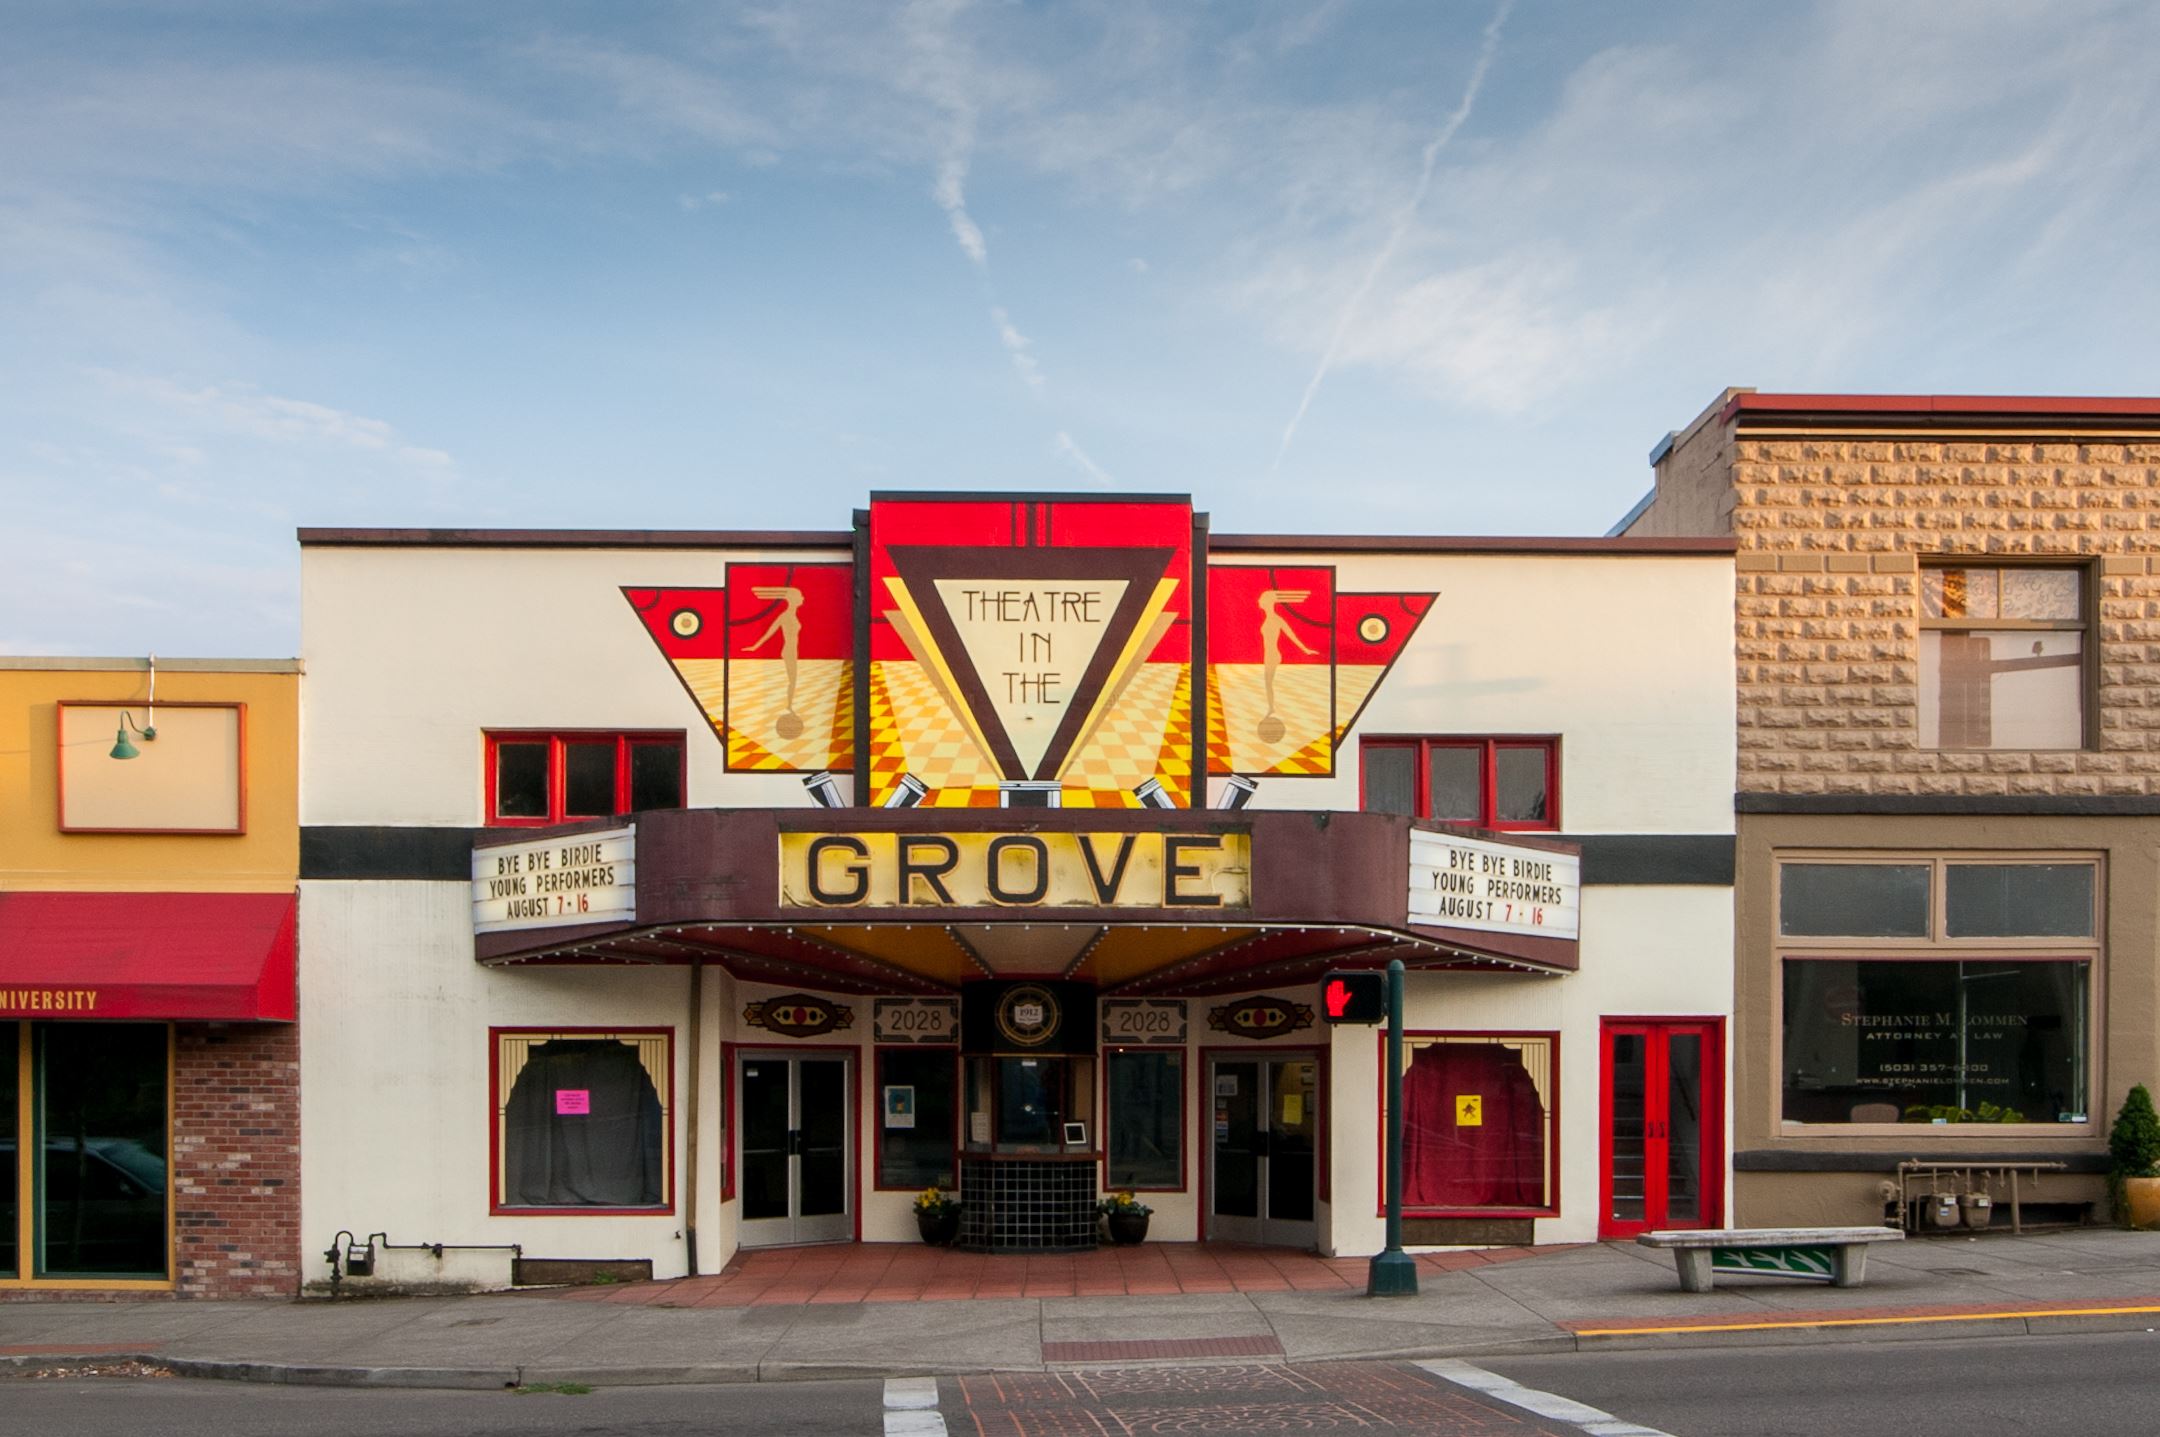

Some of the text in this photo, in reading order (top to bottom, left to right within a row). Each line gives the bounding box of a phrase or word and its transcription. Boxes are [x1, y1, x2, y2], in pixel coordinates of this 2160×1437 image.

[962, 590, 1101, 622] THEATRE
[1020, 632, 1051, 663] IN
[1002, 672, 1061, 704] THE
[498, 844, 602, 875] BYE BYE BIRDIE
[806, 833, 1225, 909] GROVE
[1450, 850, 1552, 882] BYE BYE BIRDIE
[490, 866, 614, 898] YOUNG PERFORMERS
[1432, 872, 1562, 905] YOUNG PERFORMERS
[506, 897, 549, 919] AUGUST
[1439, 896, 1493, 920] AUGUST
[1505, 904, 1512, 922] 7
[1532, 907, 1543, 925] 16
[891, 1010, 942, 1031] 2028
[1120, 1011, 1170, 1032] 2028
[1841, 1012, 1931, 1027] STEPHANIE
[1961, 1012, 2028, 1026] OMMEN
[1866, 1032, 1942, 1040] ATTORNEY
[1974, 1032, 2003, 1040] LAW
